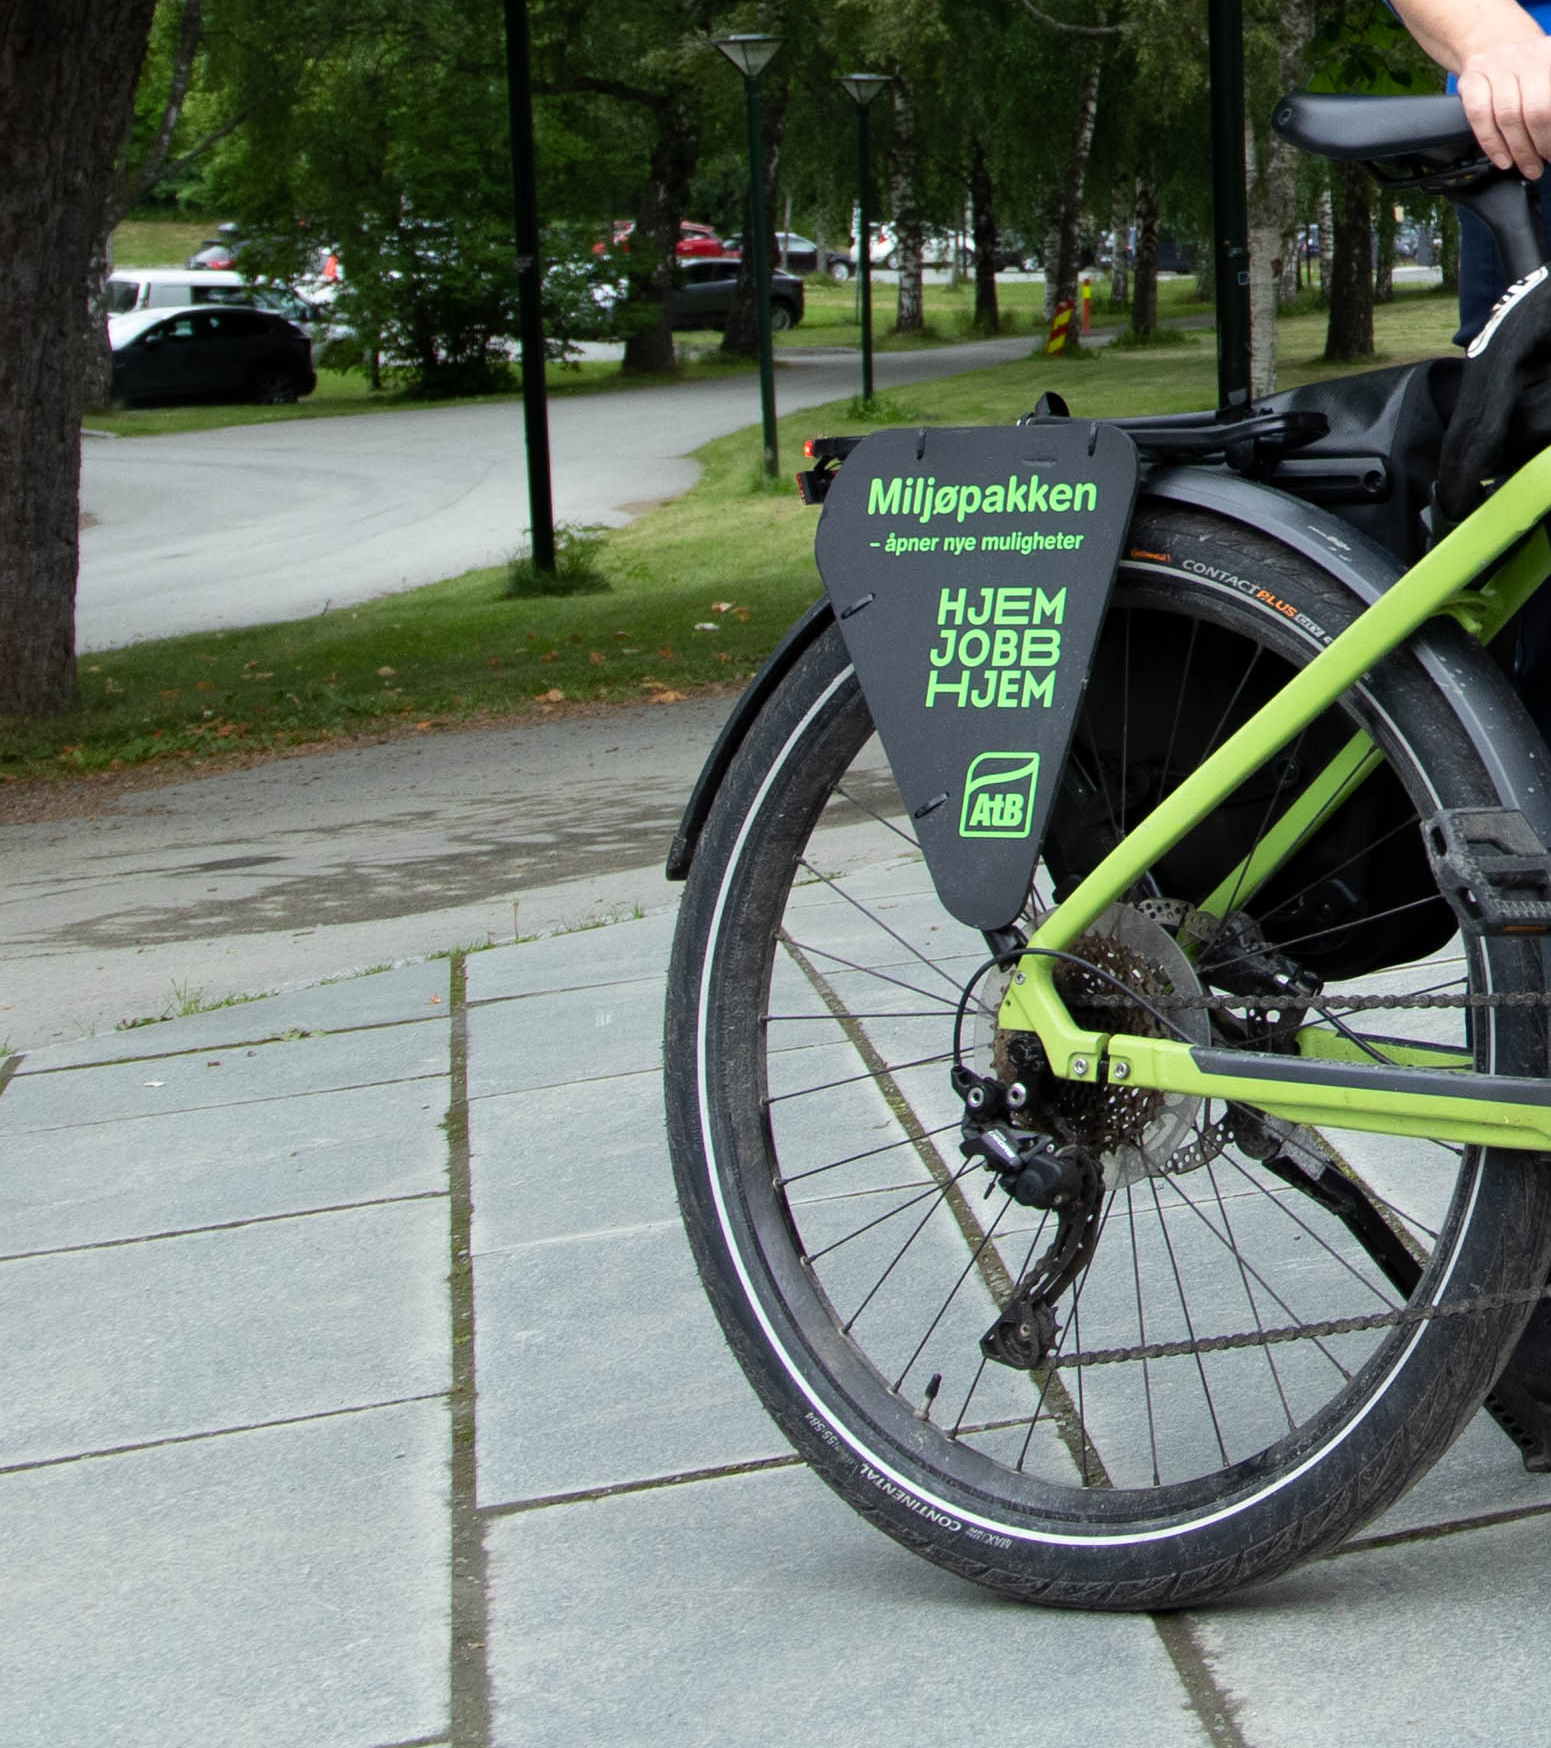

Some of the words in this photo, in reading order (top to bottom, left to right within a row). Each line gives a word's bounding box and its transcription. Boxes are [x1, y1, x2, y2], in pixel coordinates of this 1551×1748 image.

[867, 474, 1098, 523] Miljøpakken
[885, 532, 939, 556] åpner
[943, 535, 977, 556] nye
[981, 531, 1084, 555] muligheter
[936, 587, 1067, 625] HJEM
[929, 628, 1062, 667] JOBB
[925, 670, 1057, 708] HJEM
[968, 793, 1024, 827] AtB
[859, 1463, 962, 1532] CONTINENTAL
